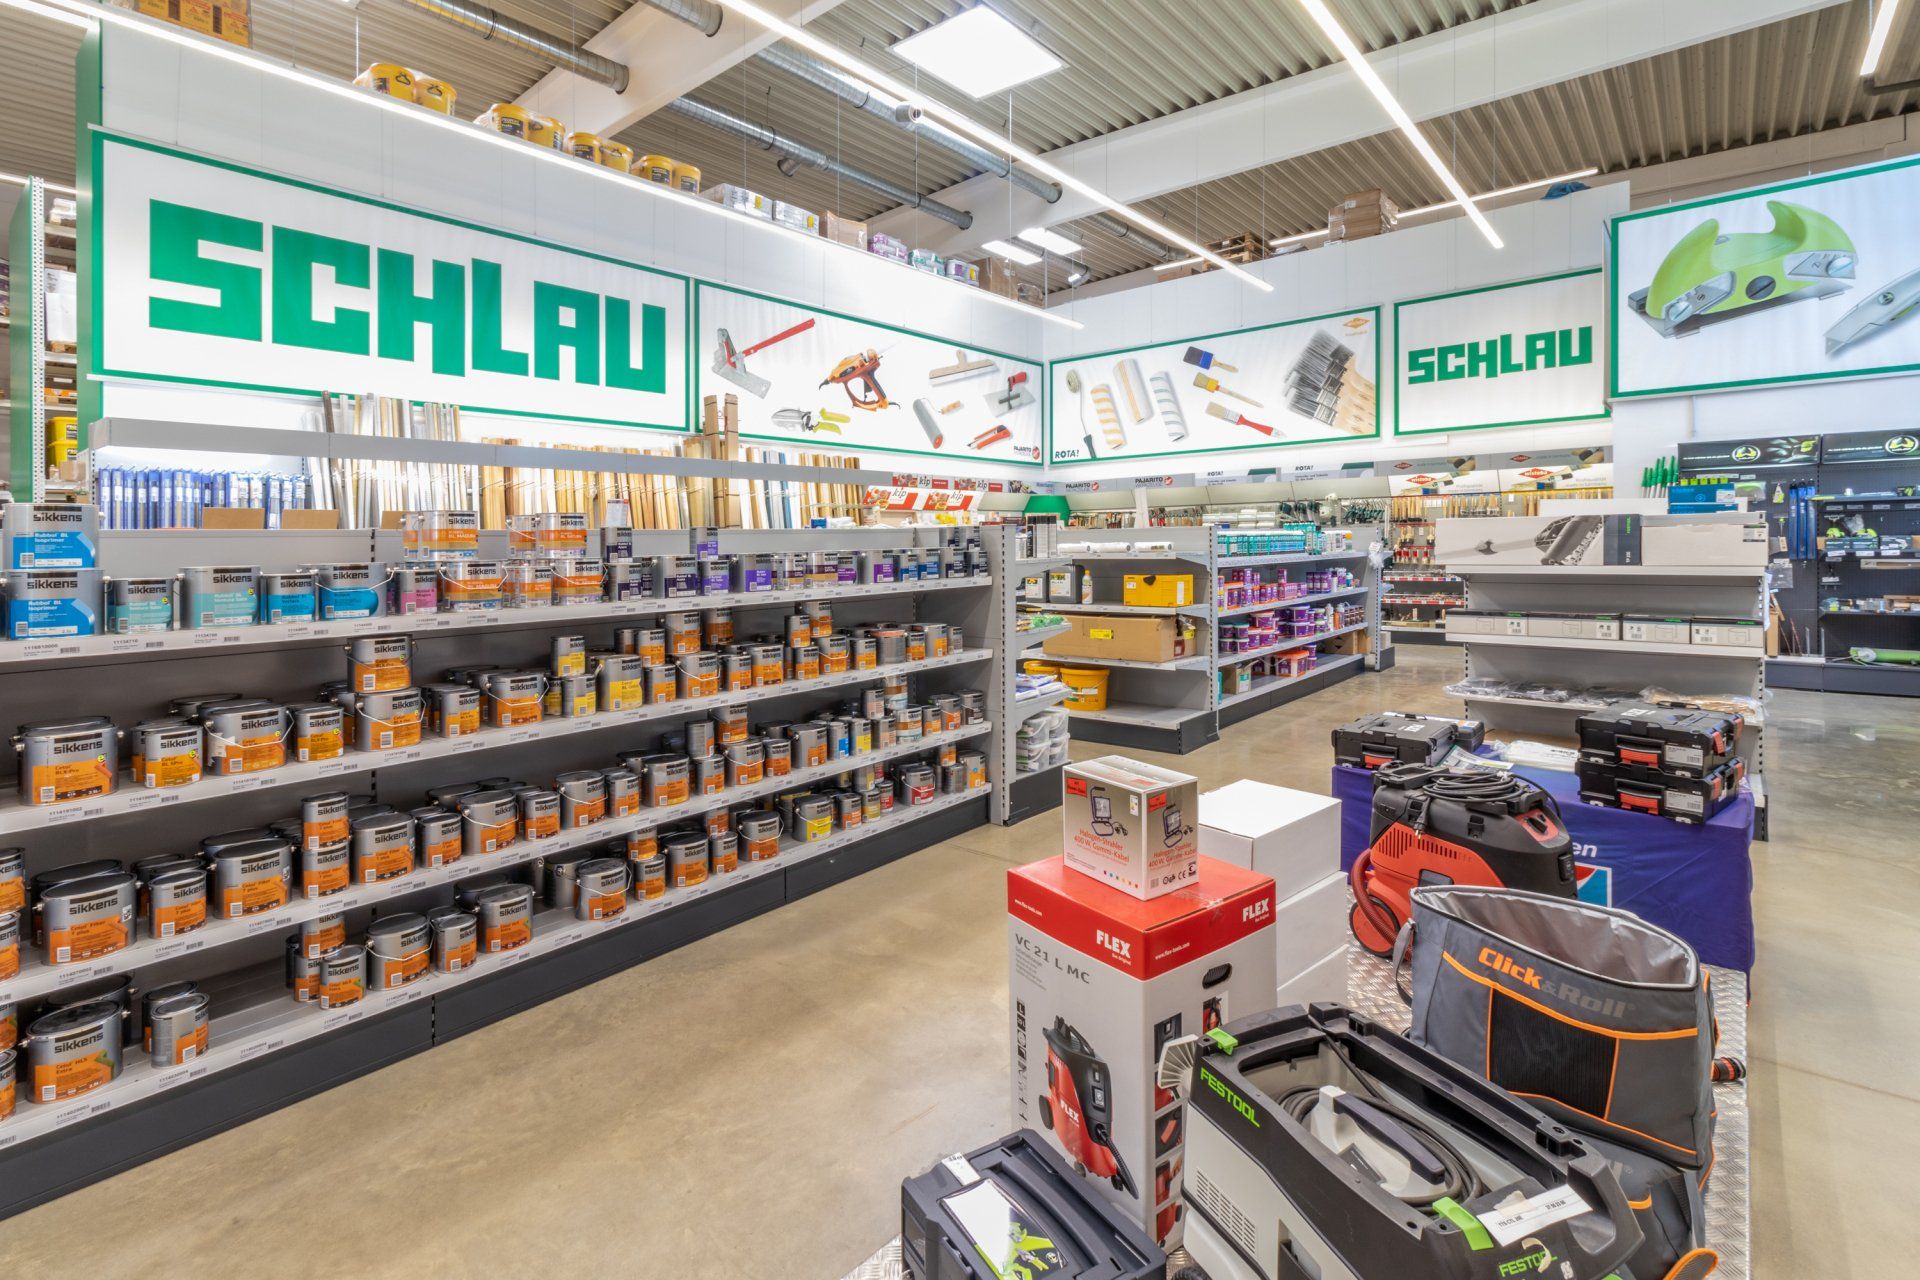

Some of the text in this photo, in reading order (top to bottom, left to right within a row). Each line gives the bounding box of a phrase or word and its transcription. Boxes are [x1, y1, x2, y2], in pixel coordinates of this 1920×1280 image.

[149, 198, 666, 394] SCHLAU
[1408, 325, 1592, 385] SCHLAU
[918, 475, 931, 487] kip
[1134, 476, 1164, 485] PAJARITO
[892, 486, 907, 499] kip
[950, 489, 964, 502] kip
[33, 512, 83, 522] sikkens
[448, 517, 475, 526] sikkens
[332, 571, 369, 580] sikkens
[467, 567, 497, 576] sikkens
[27, 579, 78, 590] sikkens
[213, 574, 252, 584] sikkens
[280, 580, 313, 589] sikkens
[128, 585, 167, 595] sikkens
[374, 644, 406, 654] sikkens
[510, 682, 538, 691] sikkens
[392, 699, 420, 710] sikkens
[241, 717, 279, 730] sikkens
[309, 717, 341, 728] sikkens
[54, 740, 103, 755] sikkens
[160, 737, 198, 749] sikkens
[317, 803, 348, 816] sikkens
[374, 830, 408, 844] sikkens
[317, 852, 348, 864] sikkens
[240, 860, 280, 875] sikkens
[69, 897, 118, 915] sikkens
[499, 904, 528, 917] sikkens
[1242, 898, 1270, 922] FLEX
[1096, 929, 1131, 959] FLEX
[1015, 933, 1030, 951] VC
[1033, 944, 1050, 963] 21
[1067, 965, 1090, 984] MC
[327, 964, 360, 977] sikkens
[54, 1032, 104, 1054] sikkens
[1200, 1067, 1261, 1128] FESTOOL
[1060, 1099, 1080, 1124] FLEX
